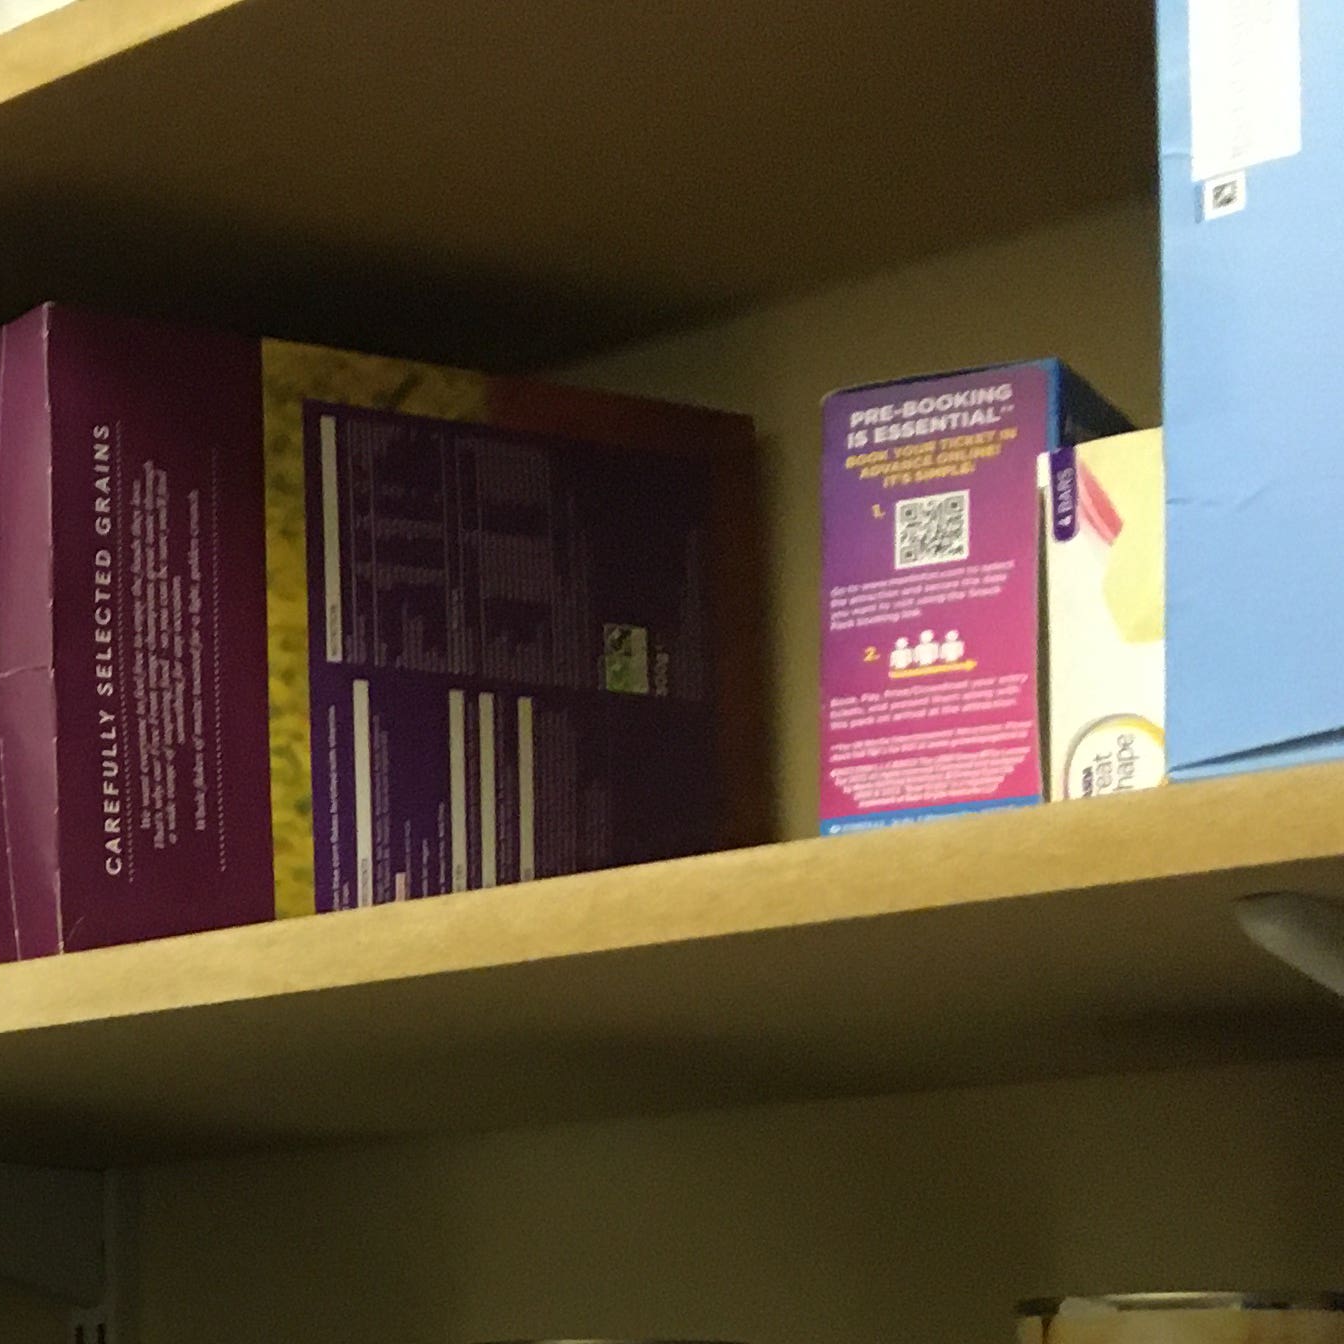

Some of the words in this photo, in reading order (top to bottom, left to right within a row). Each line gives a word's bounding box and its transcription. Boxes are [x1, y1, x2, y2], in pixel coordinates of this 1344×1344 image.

[847, 429, 868, 450] IS
[849, 383, 1013, 429] PRE-BOOKING
[92, 423, 112, 536] GRAINS
[95, 549, 116, 697] SELECTED
[98, 706, 124, 878] CAREFULLY
[1117, 733, 1140, 791] hape
